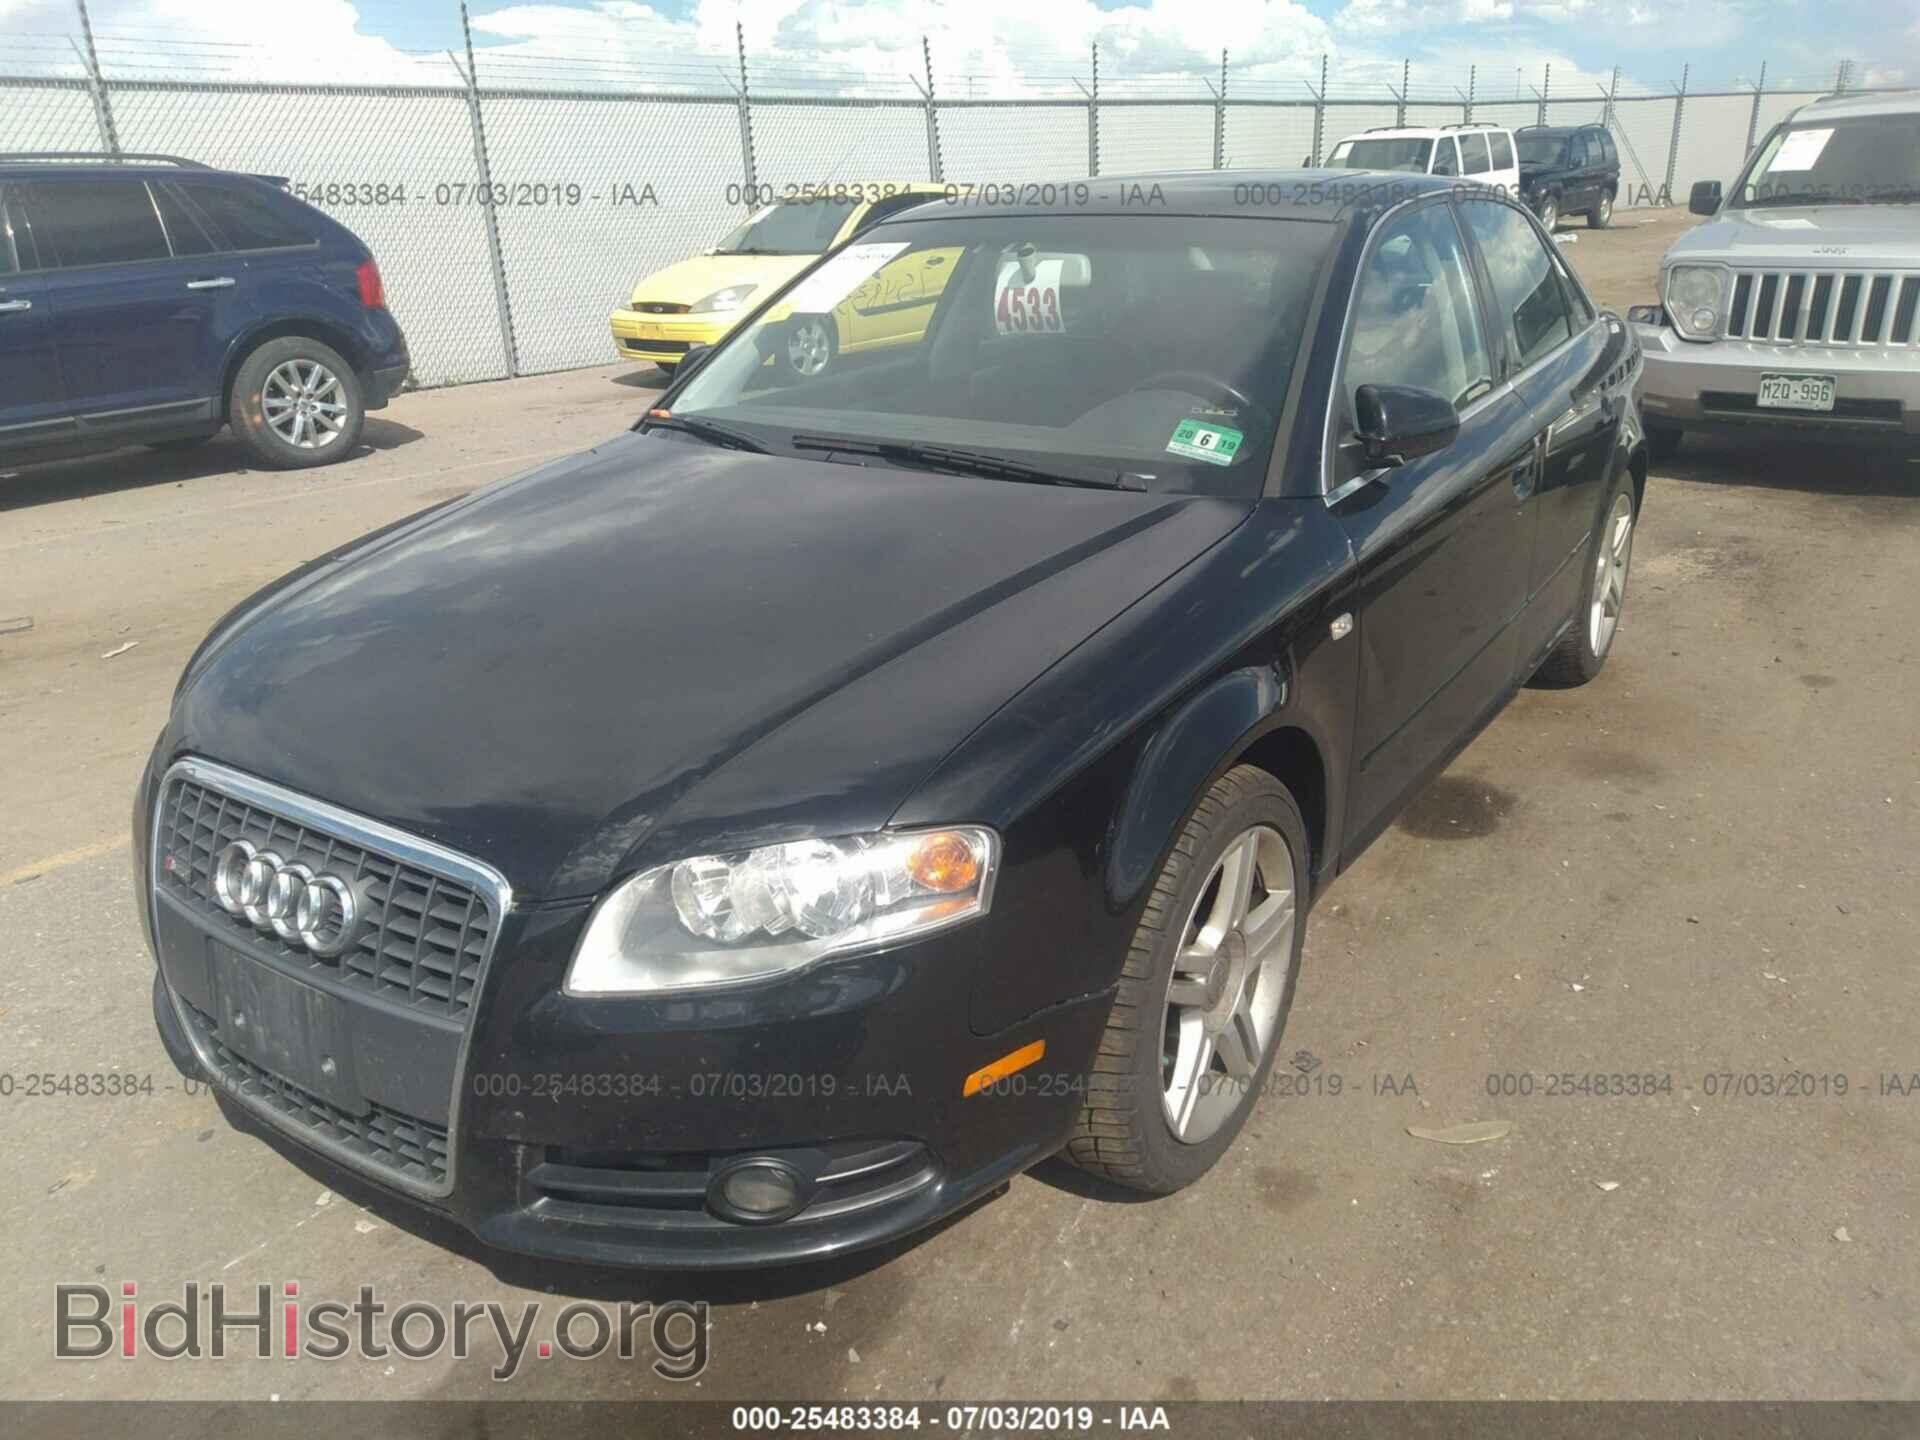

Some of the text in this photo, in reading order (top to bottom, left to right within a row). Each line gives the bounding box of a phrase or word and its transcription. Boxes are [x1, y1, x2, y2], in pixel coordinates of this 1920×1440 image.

[997, 287, 1058, 332] 4533
[1178, 429, 1237, 450] 20 6 19
